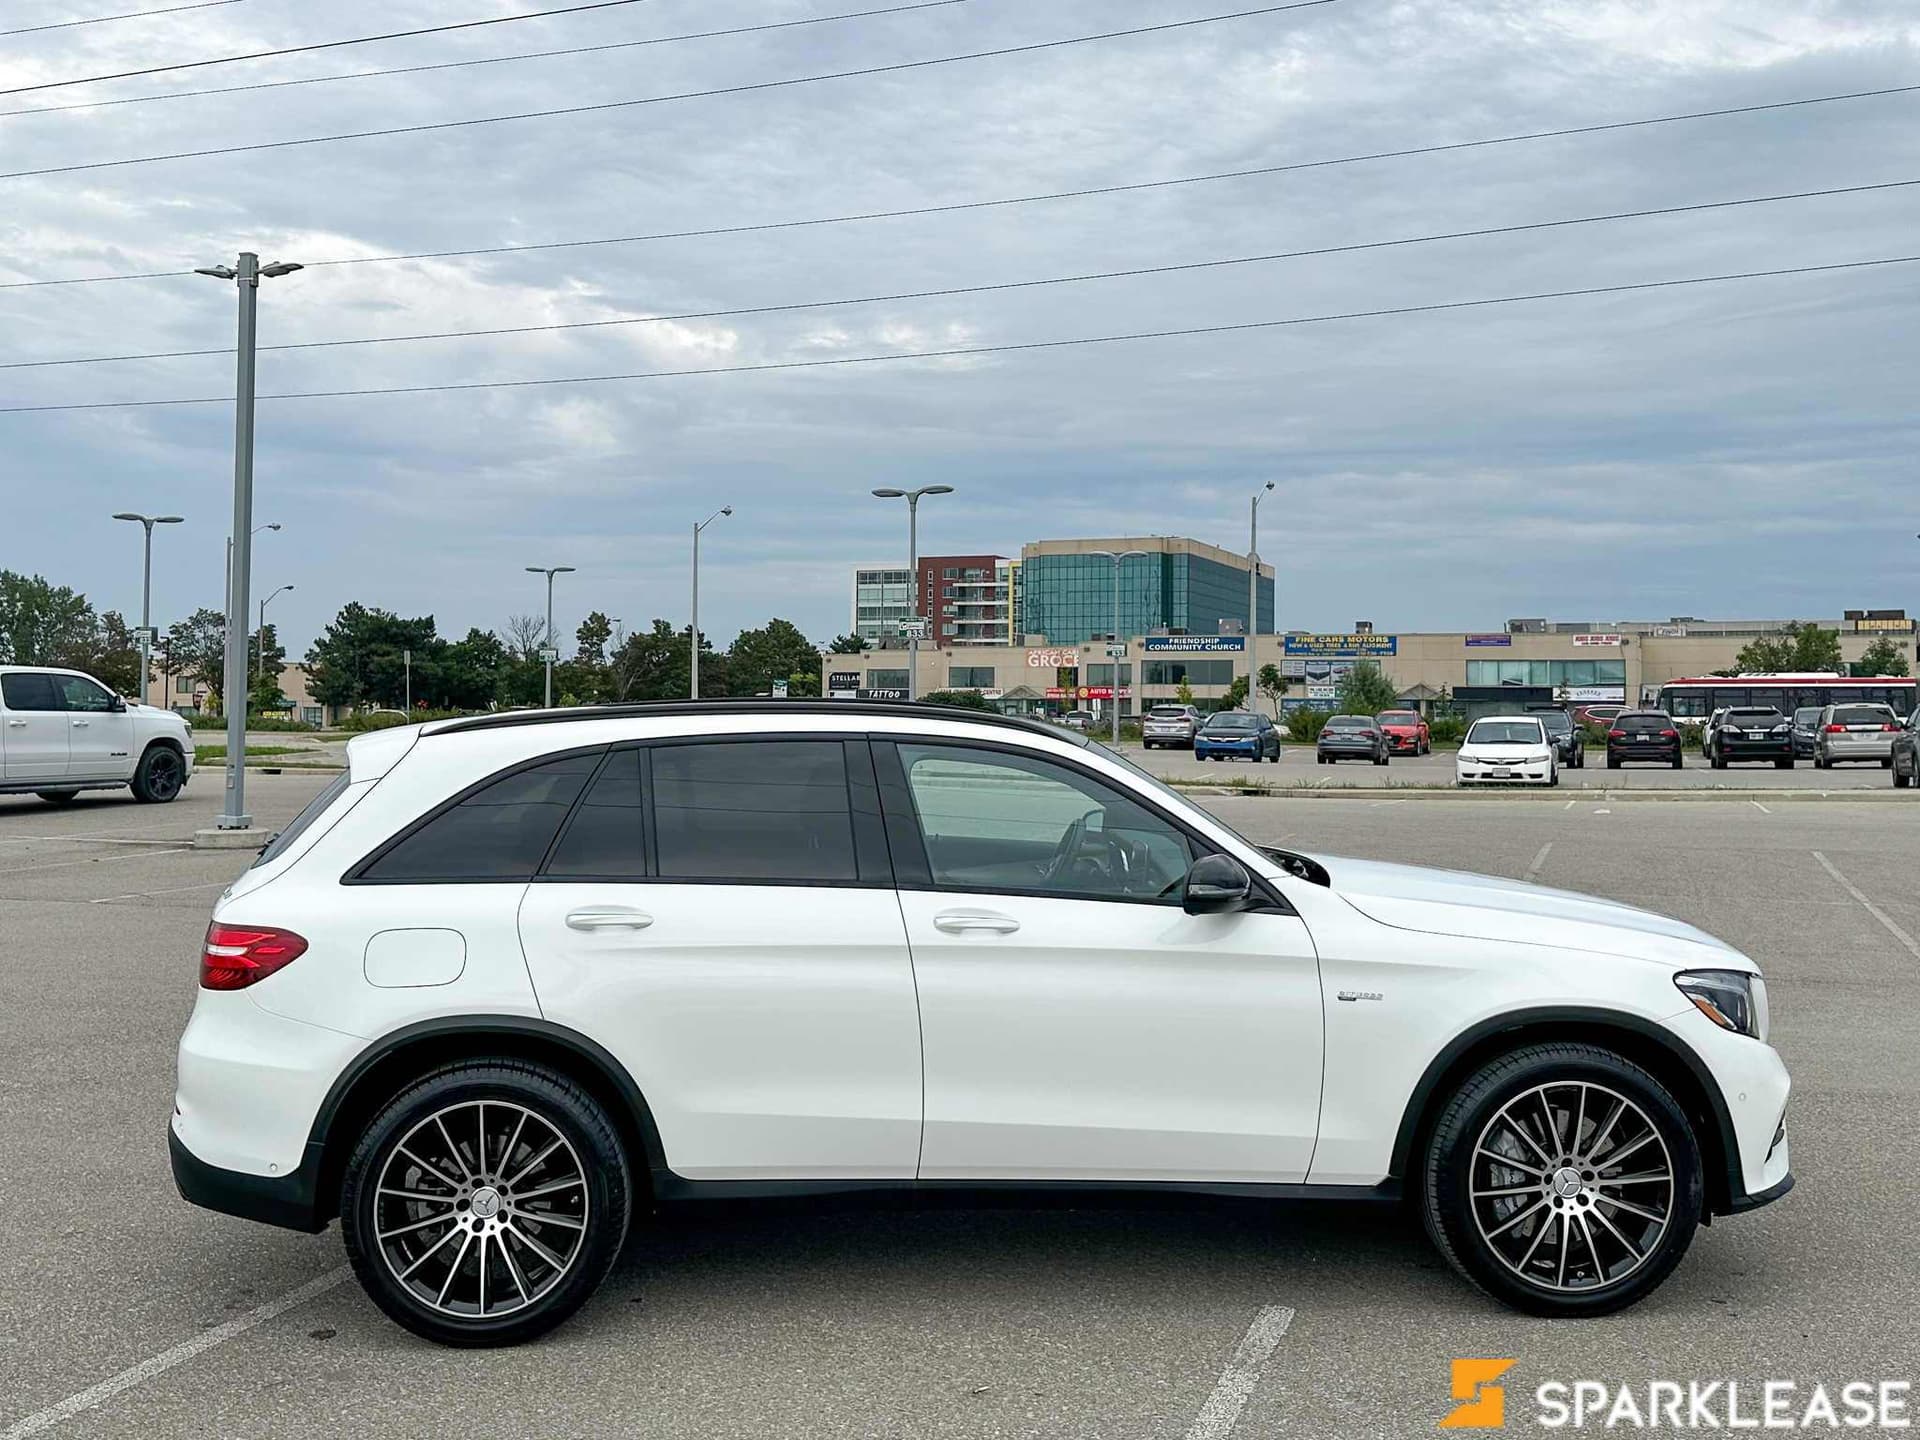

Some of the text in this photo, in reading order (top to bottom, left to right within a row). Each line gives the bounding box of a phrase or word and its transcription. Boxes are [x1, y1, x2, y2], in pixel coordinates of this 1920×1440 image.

[1295, 635, 1315, 643] FINE
[1347, 635, 1389, 643] MOTORS
[868, 690, 901, 699] TATTOO
